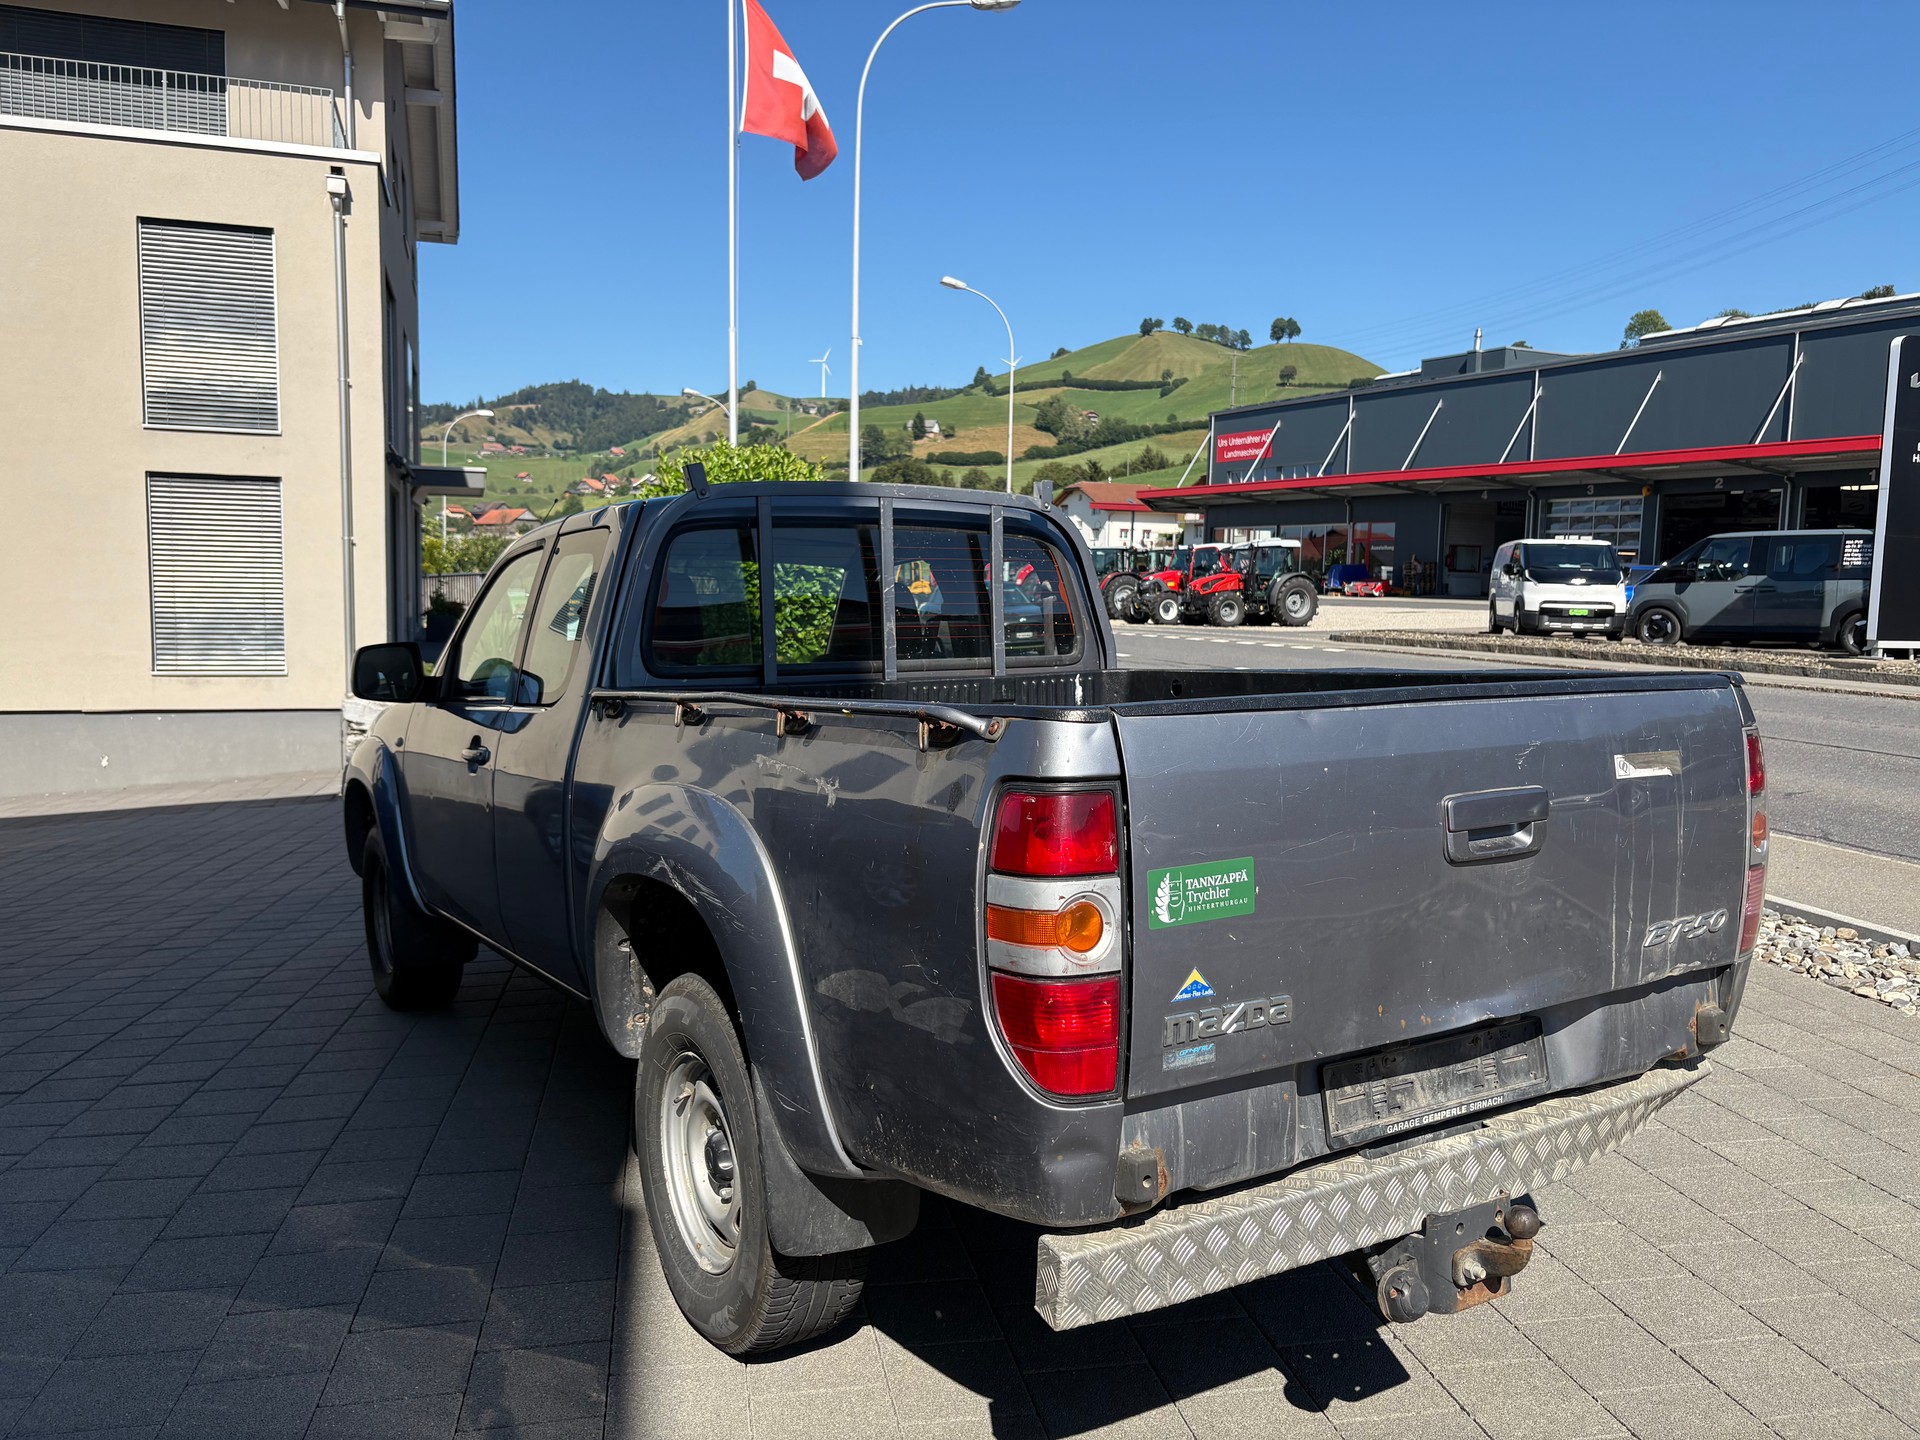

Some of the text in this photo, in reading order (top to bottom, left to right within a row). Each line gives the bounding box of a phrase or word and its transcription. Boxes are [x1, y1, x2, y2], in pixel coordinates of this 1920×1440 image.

[1217, 438, 1228, 447] Urs
[1223, 448, 1264, 458] Landmaschine
[1869, 469, 1876, 482] 1
[1714, 477, 1724, 489] 2
[1481, 490, 1488, 500] 4
[1586, 484, 1595, 495] 3
[1185, 869, 1248, 889] TANNZAPFÄ
[1186, 886, 1231, 904] Trychler
[1188, 897, 1249, 912] HINTERTHURGAU
[1387, 1096, 1503, 1133] GARAGE GEMPERLE SIRNACH
